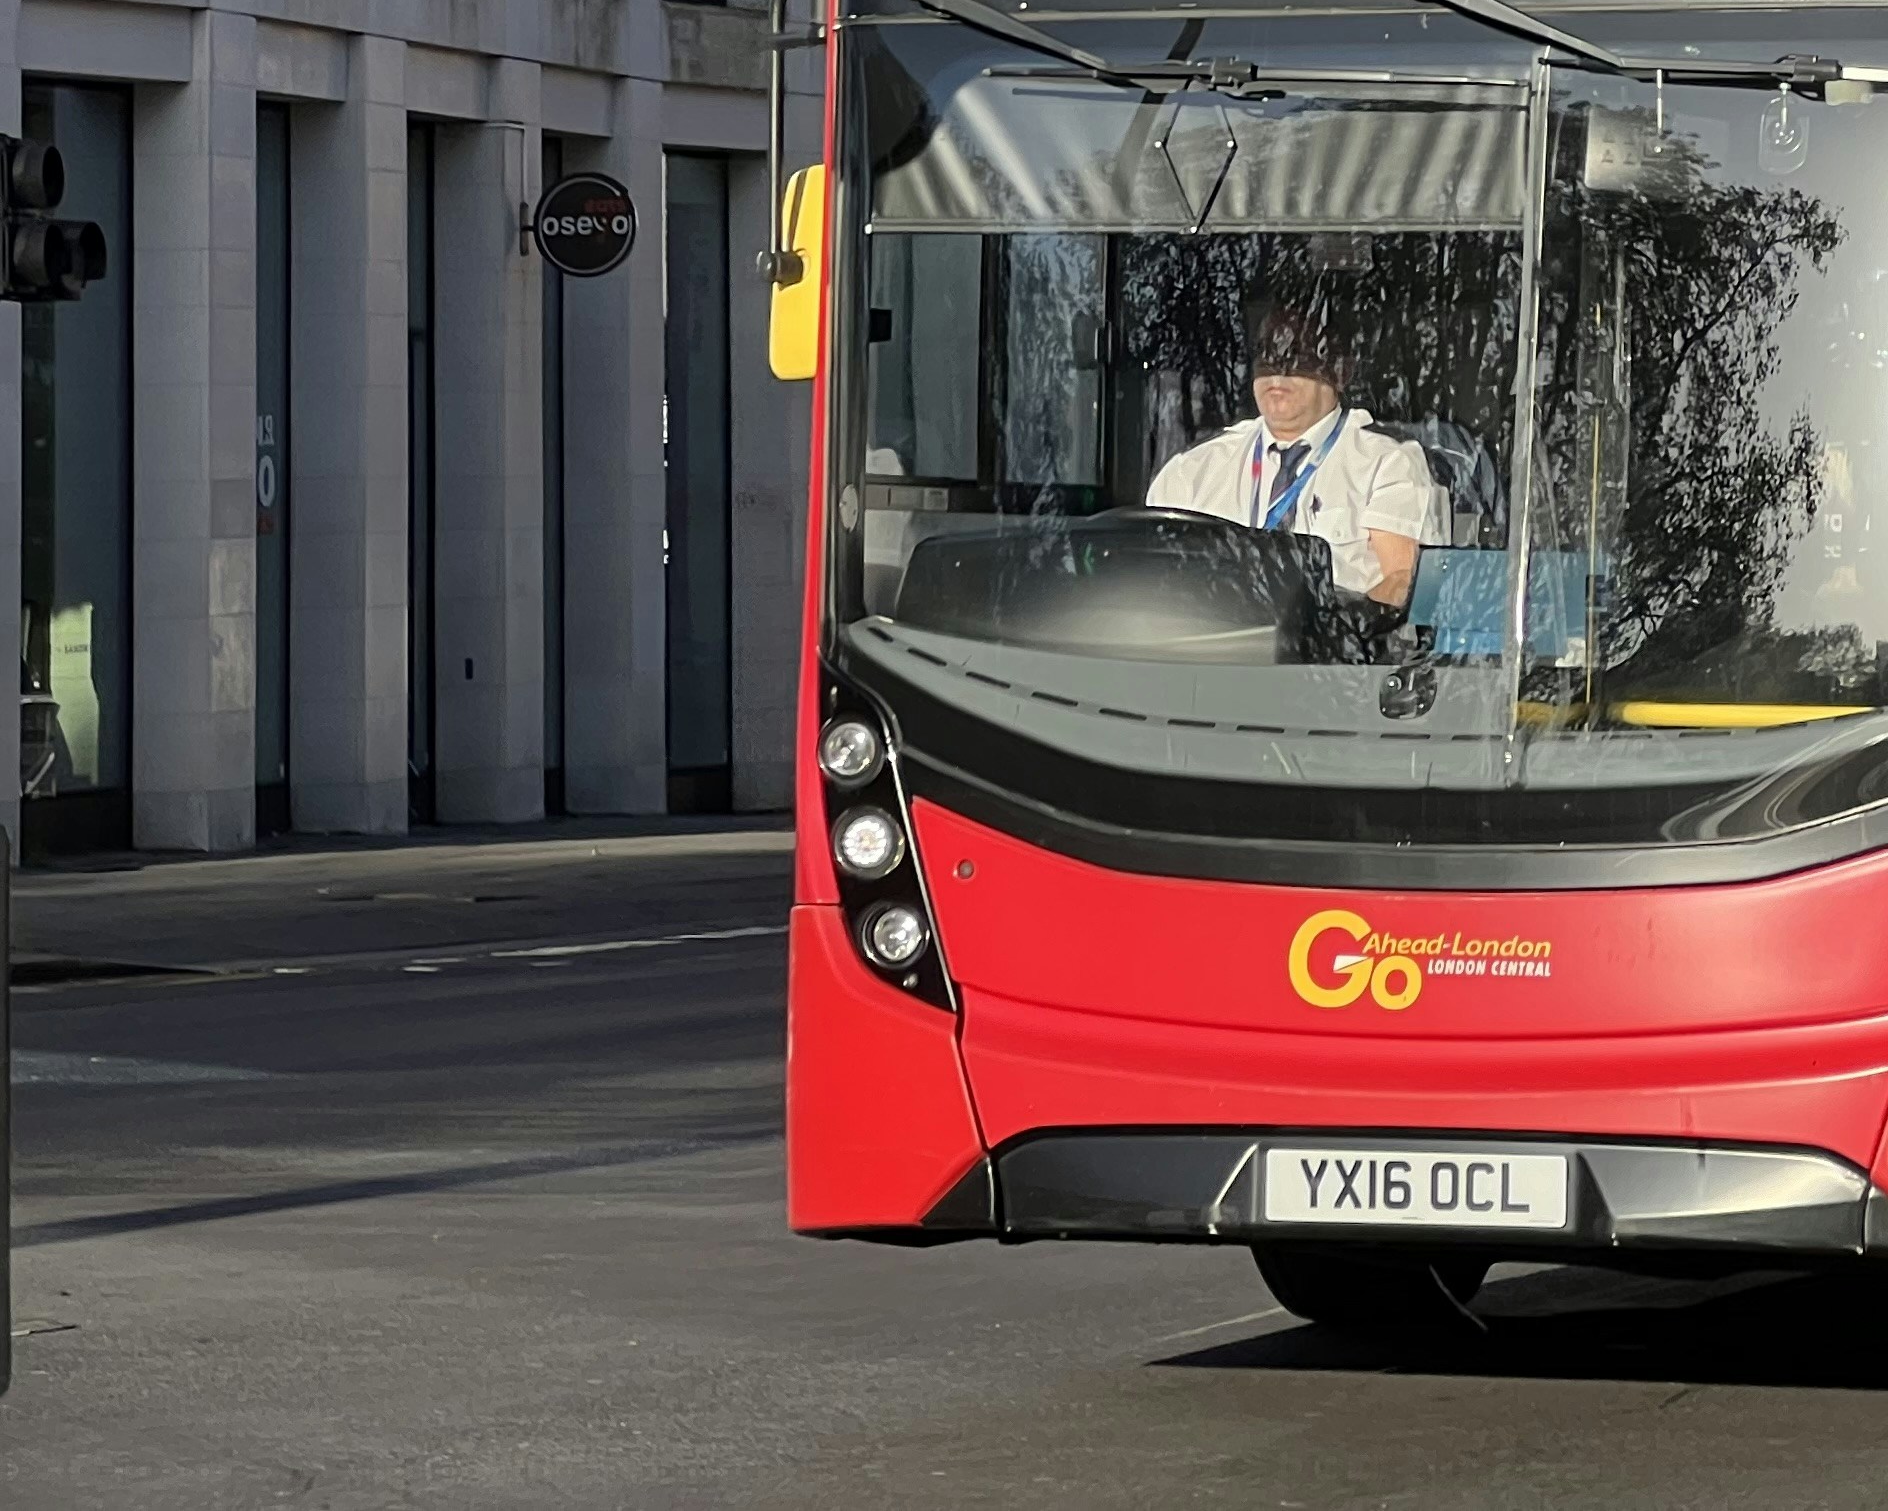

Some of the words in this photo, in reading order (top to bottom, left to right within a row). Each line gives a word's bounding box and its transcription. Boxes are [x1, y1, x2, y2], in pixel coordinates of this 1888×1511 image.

[1288, 910, 1422, 1010] Go
[1362, 932, 1551, 958] Ahead-London
[1427, 959, 1486, 975] LONDON
[1491, 959, 1551, 977] CENTRAL
[1300, 1159, 1412, 1209] YX16
[1430, 1161, 1530, 1213] OCL
